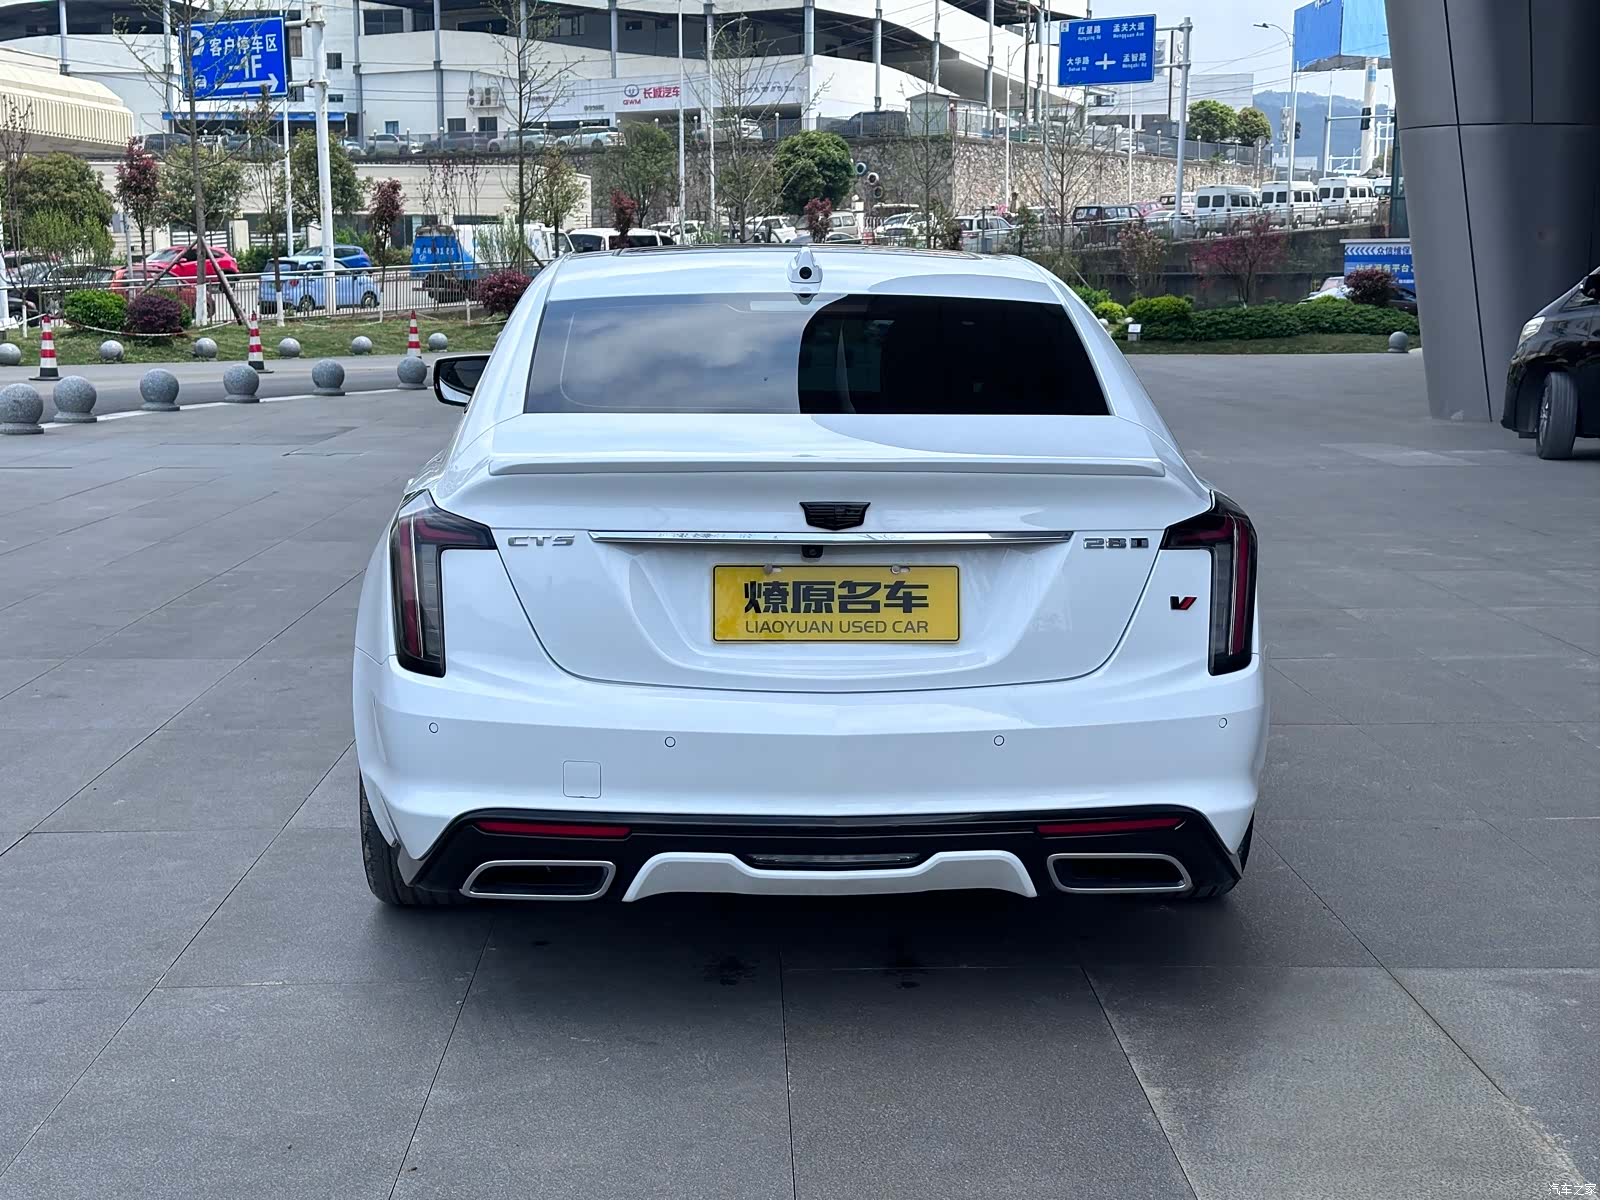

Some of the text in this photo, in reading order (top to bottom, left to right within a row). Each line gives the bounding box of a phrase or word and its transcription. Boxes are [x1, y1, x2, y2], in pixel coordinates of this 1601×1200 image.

[1078, 25, 1101, 35] 红星路
[1113, 22, 1145, 33] 孟关大道
[209, 33, 278, 57] 客户停车区
[1066, 56, 1090, 66] 大华路
[1122, 52, 1147, 63] 孟智路
[643, 86, 680, 99] 长城汽车
[1346, 264, 1414, 273] 一站式服务平台
[1083, 537, 1149, 550] 28T
[744, 580, 929, 614] 燎原名车
[745, 620, 929, 634] LIAOYUAN USED CAR
